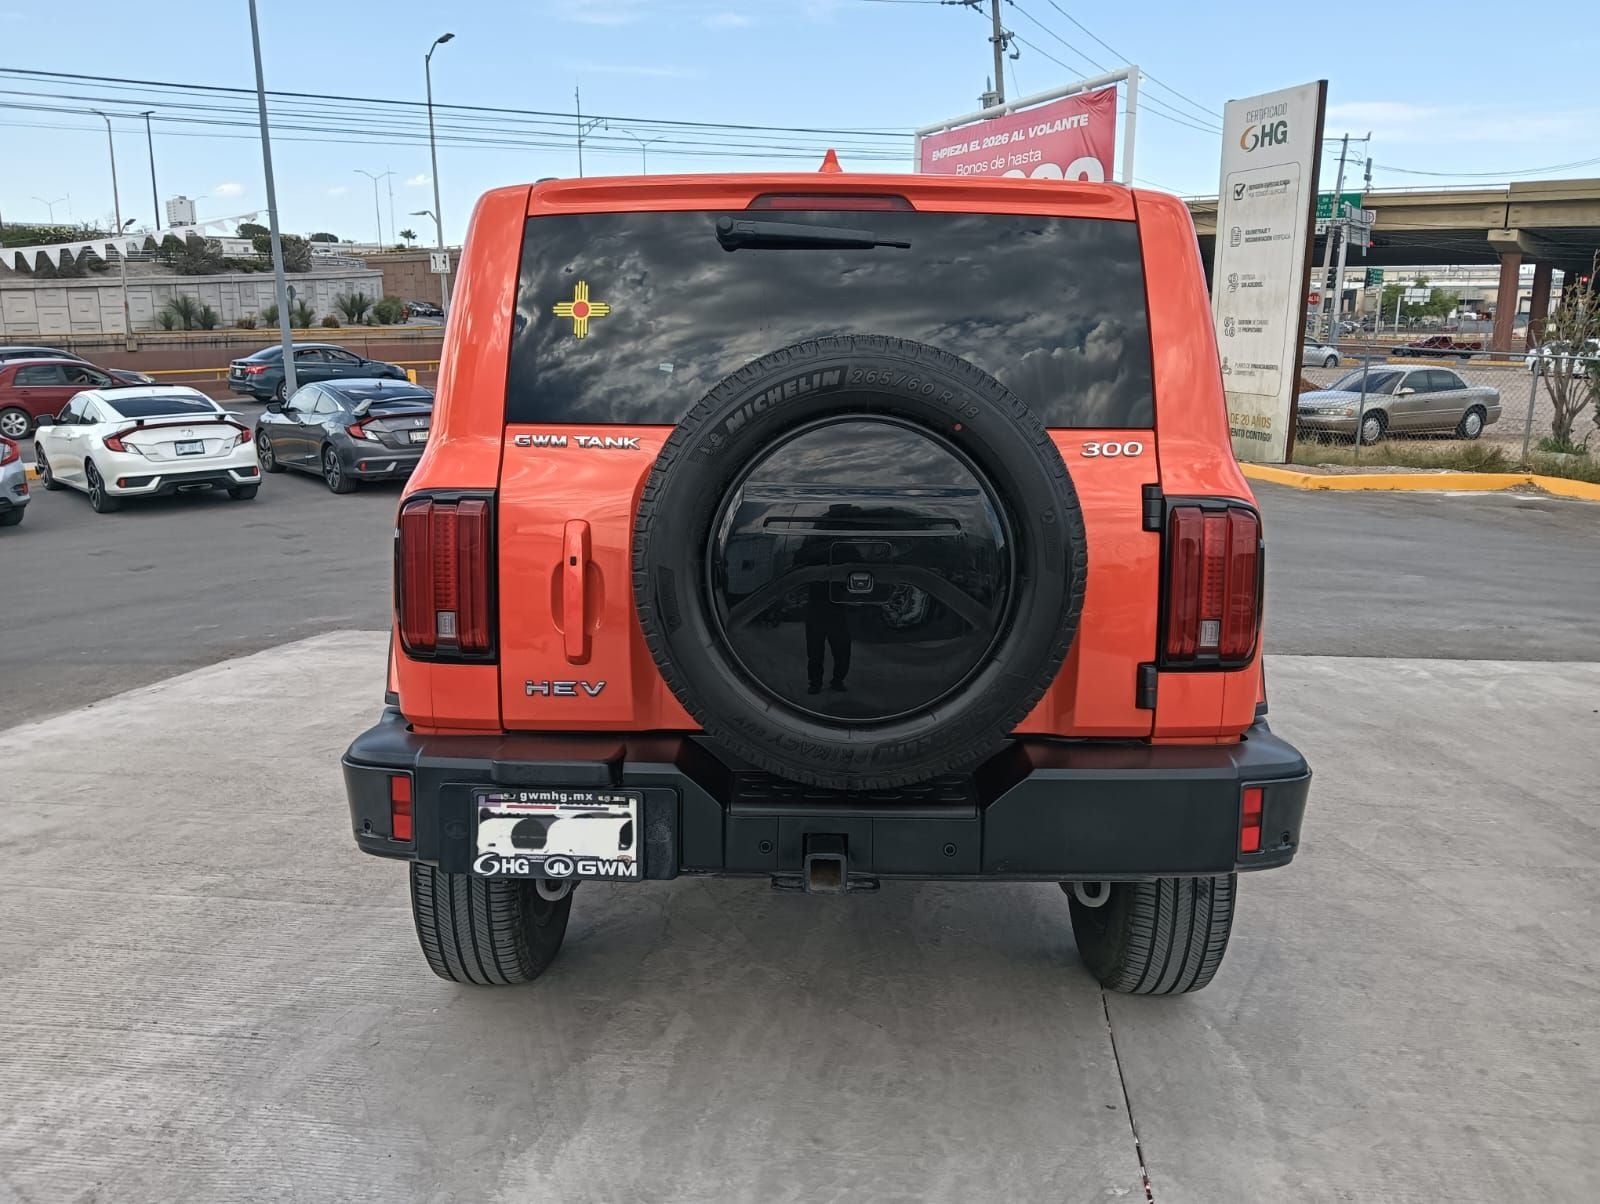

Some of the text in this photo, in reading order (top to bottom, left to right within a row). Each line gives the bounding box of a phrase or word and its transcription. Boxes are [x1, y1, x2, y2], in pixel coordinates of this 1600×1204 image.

[1246, 102, 1288, 123] CERTIFICADO
[931, 113, 1089, 161] EMPIEZA EL 2026 AL VOLANTE
[956, 161, 988, 176] Bonos
[990, 154, 1006, 169] de
[1007, 149, 1042, 167] hasta
[725, 369, 981, 434] MICHELIN 265/60 R 18
[1231, 412, 1240, 425] DE
[1241, 413, 1250, 426] 20
[1230, 427, 1245, 438] ENTO
[514, 434, 641, 450] GWM TANK
[1080, 440, 1144, 458] 300
[525, 680, 606, 697] HEV
[520, 791, 593, 802] gwmhg.mx
[577, 860, 638, 877] GWM
